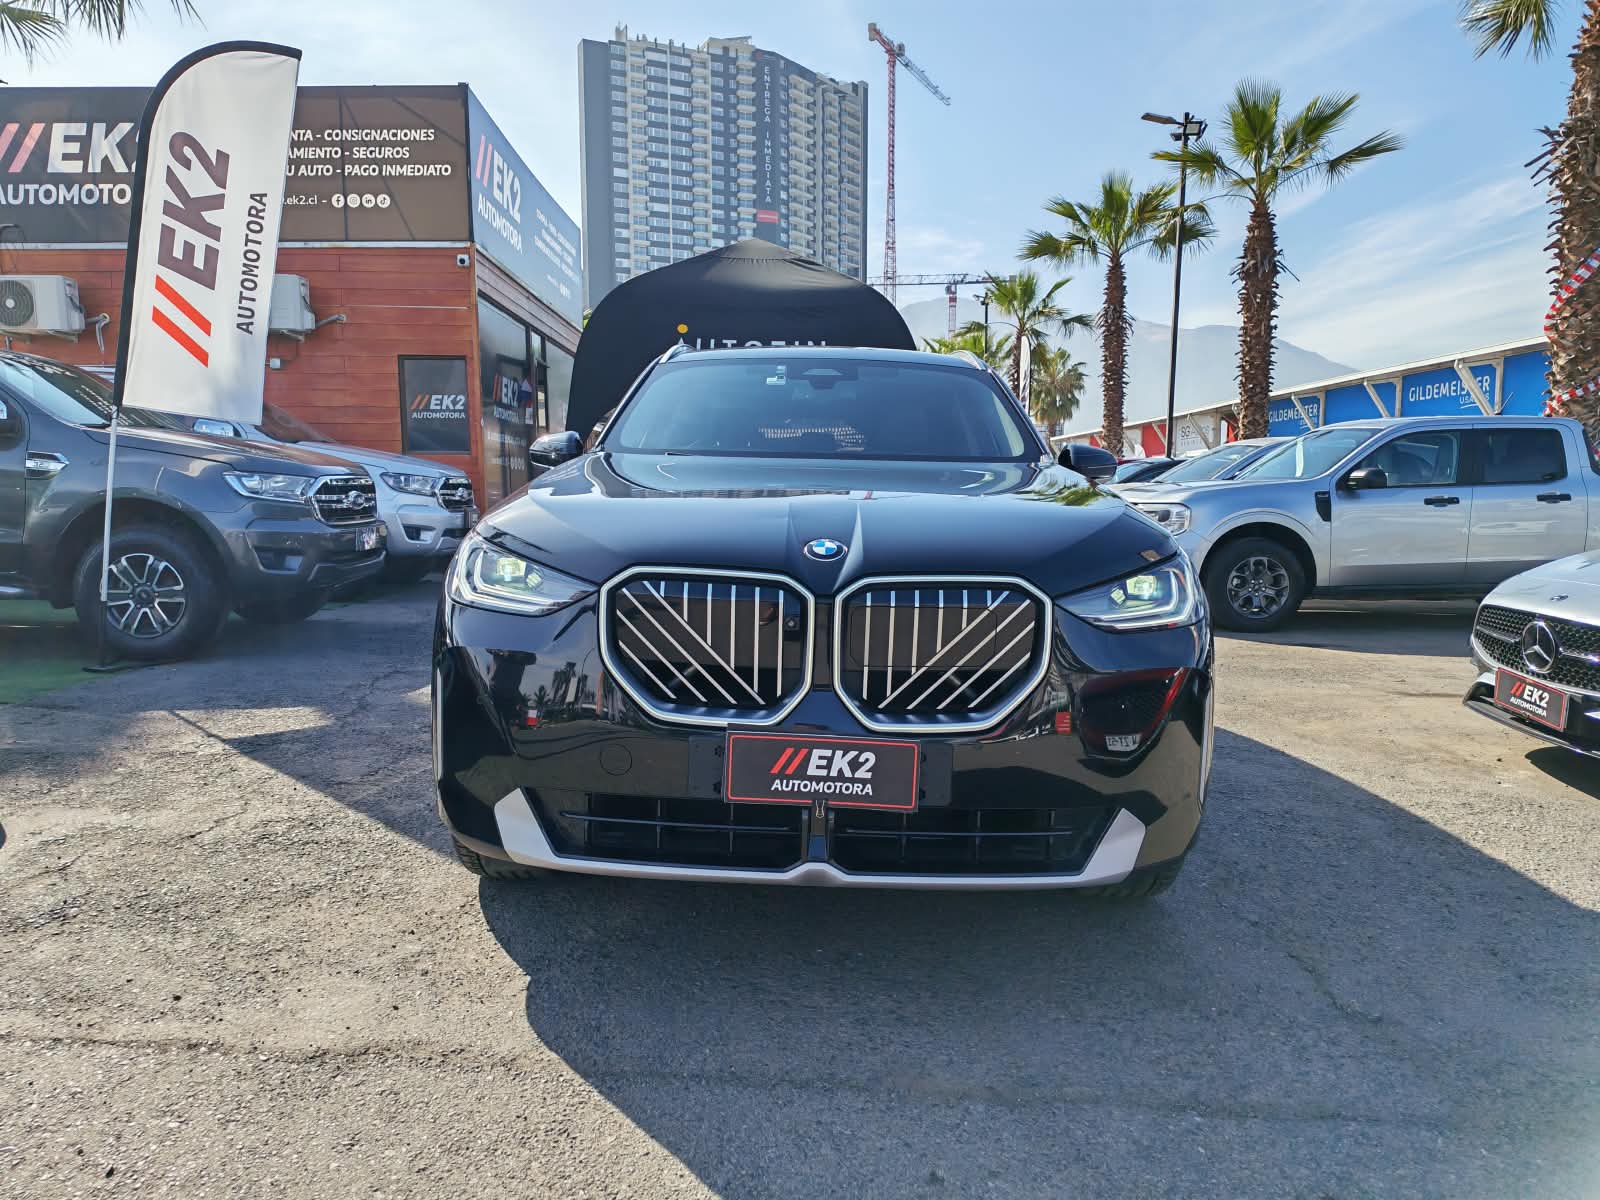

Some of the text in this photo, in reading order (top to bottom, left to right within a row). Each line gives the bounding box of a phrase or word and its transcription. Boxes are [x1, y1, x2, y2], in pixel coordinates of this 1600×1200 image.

[324, 129, 435, 141] CONSIGNACIONES
[47, 122, 139, 173] EK
[352, 146, 410, 159] SEGUROS
[298, 164, 333, 177] AUTO
[344, 164, 379, 177] PAGO
[382, 164, 452, 177] INMEDIATO
[764, 131, 772, 202] INMEDIATA
[478, 191, 522, 255] AUTOMOTORA
[236, 192, 268, 335] AUTOMOTORA
[1409, 375, 1490, 402] GILDEMEISER
[411, 411, 466, 420] AUTOMOTORA
[1268, 403, 1318, 423] GILDEMEITER
[1510, 696, 1547, 718] AUTOMOTORA
[770, 779, 873, 796] AUTOMOTORA
